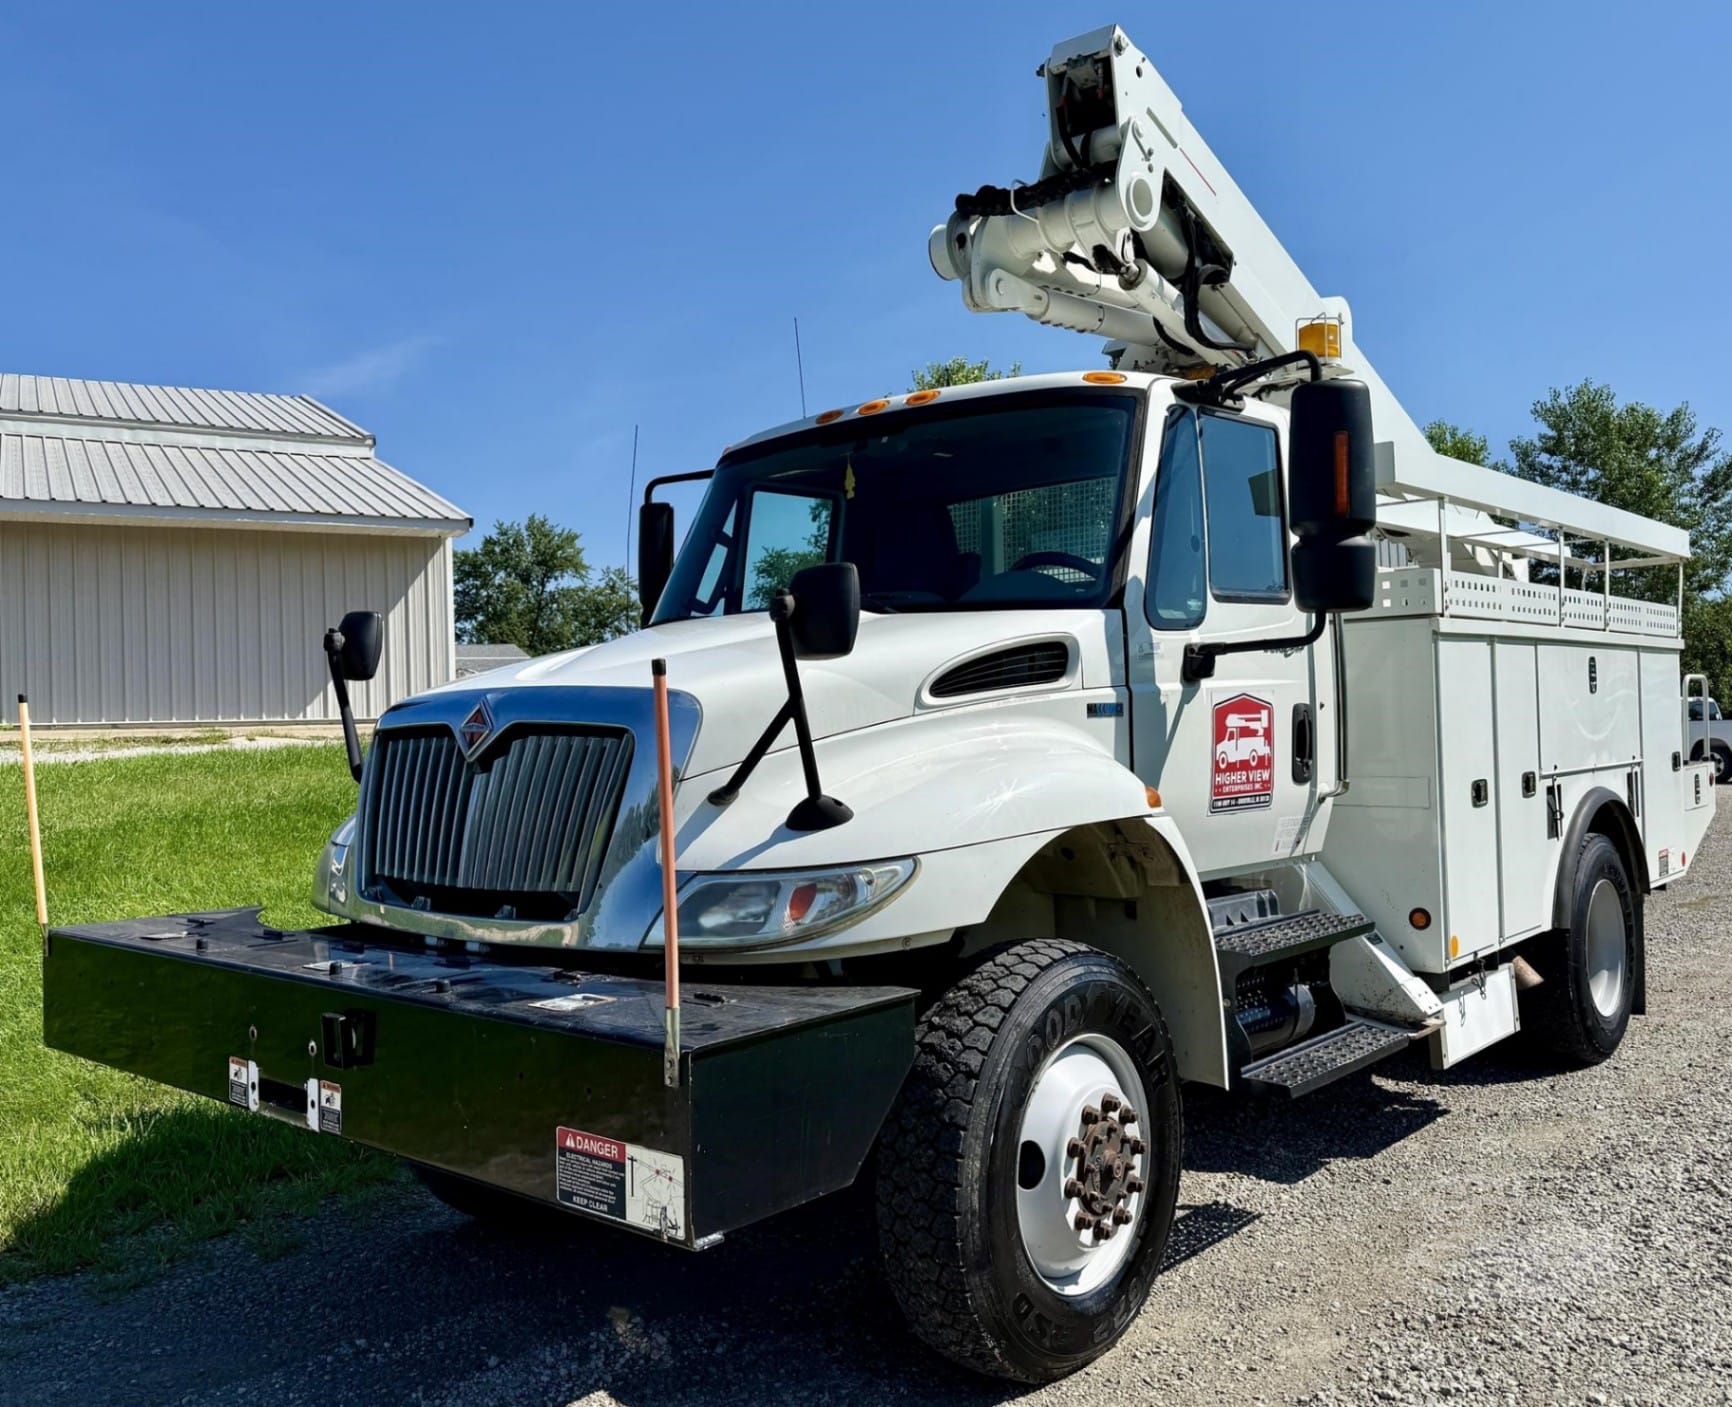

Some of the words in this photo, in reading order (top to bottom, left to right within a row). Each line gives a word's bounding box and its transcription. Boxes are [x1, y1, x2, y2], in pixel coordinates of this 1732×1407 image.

[1215, 772, 1247, 785] HIGHER
[1248, 769, 1270, 782] VIEW
[1012, 981, 1169, 1104] OODYEAR
[576, 1136, 617, 1158] DANGER
[572, 1196, 588, 1206] KEEP
[588, 1200, 608, 1212] CLEAR
